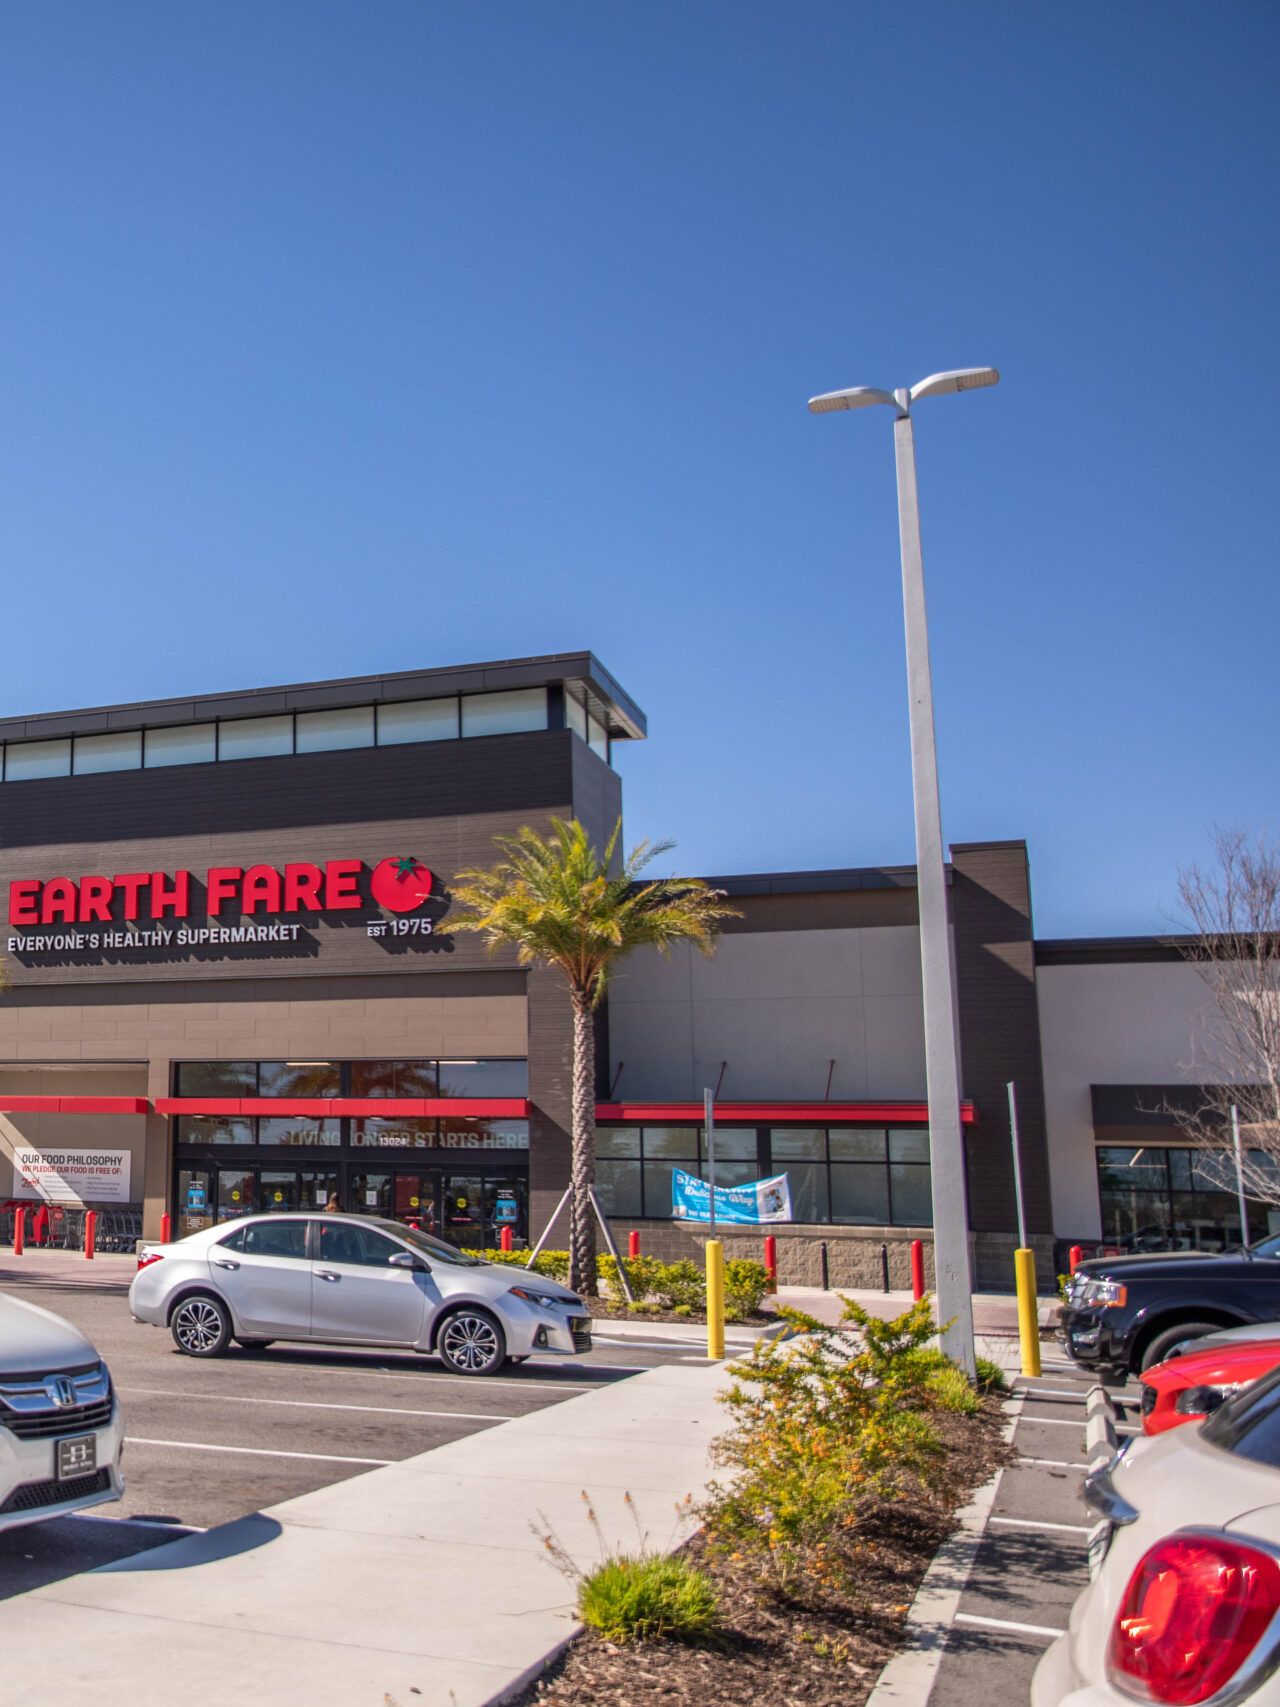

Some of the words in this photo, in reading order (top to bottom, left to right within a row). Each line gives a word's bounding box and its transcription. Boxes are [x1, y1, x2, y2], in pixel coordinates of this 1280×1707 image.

[9, 870, 190, 926] EARTH
[207, 859, 364, 916] FARE
[366, 925, 388, 937] EST
[390, 918, 433, 937] 1975
[7, 933, 100, 952] EVERYONE'S
[104, 929, 173, 948] HEALTHY
[176, 924, 301, 946] SUPERMARKET
[290, 1131, 340, 1146] LIVING
[483, 1133, 529, 1149] HERE
[379, 1137, 407, 1146] 13024
[22, 1154, 40, 1164] OUR
[42, 1154, 65, 1165] FOOD
[67, 1155, 123, 1166] PHILOSOPHY
[32, 1165, 56, 1173] PLEDGE
[70, 1166, 88, 1174] FOOD
[95, 1167, 111, 1175] FREE
